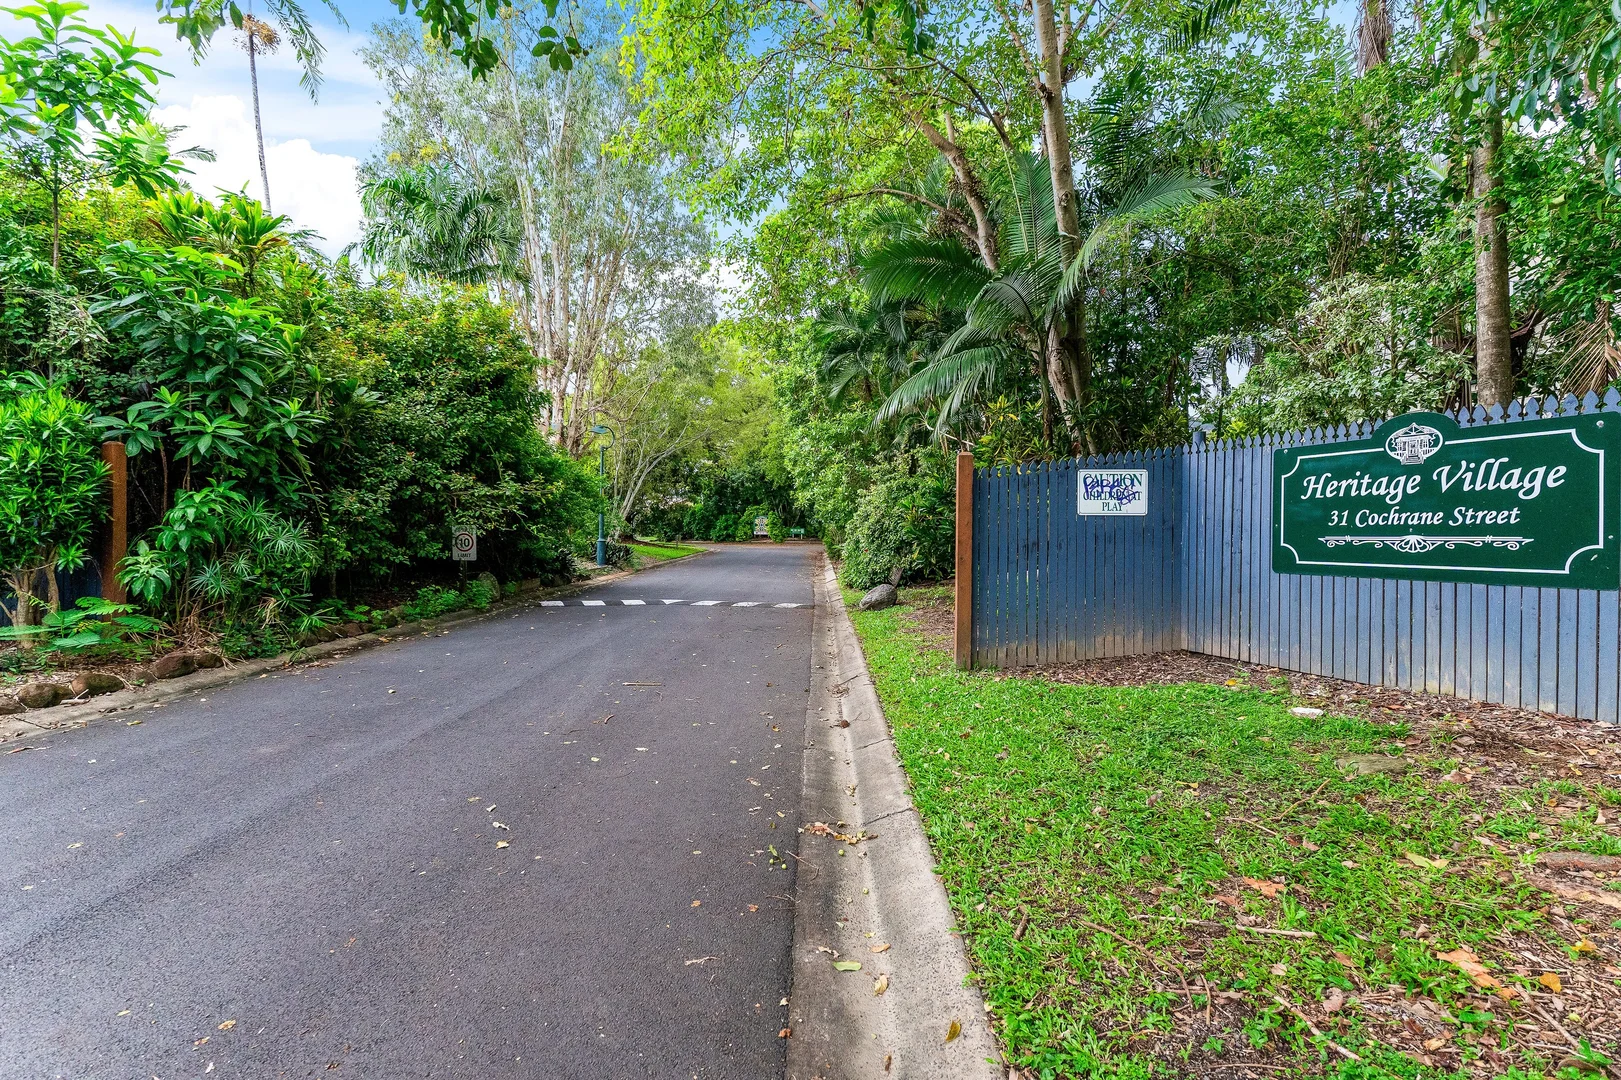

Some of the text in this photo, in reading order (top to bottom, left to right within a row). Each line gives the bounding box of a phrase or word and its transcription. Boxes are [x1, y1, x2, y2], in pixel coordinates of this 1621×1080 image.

[1301, 457, 1567, 504] Heritage Village
[1102, 501, 1123, 512] PLAY
[1328, 506, 1520, 527] 31 Cochrane Street
